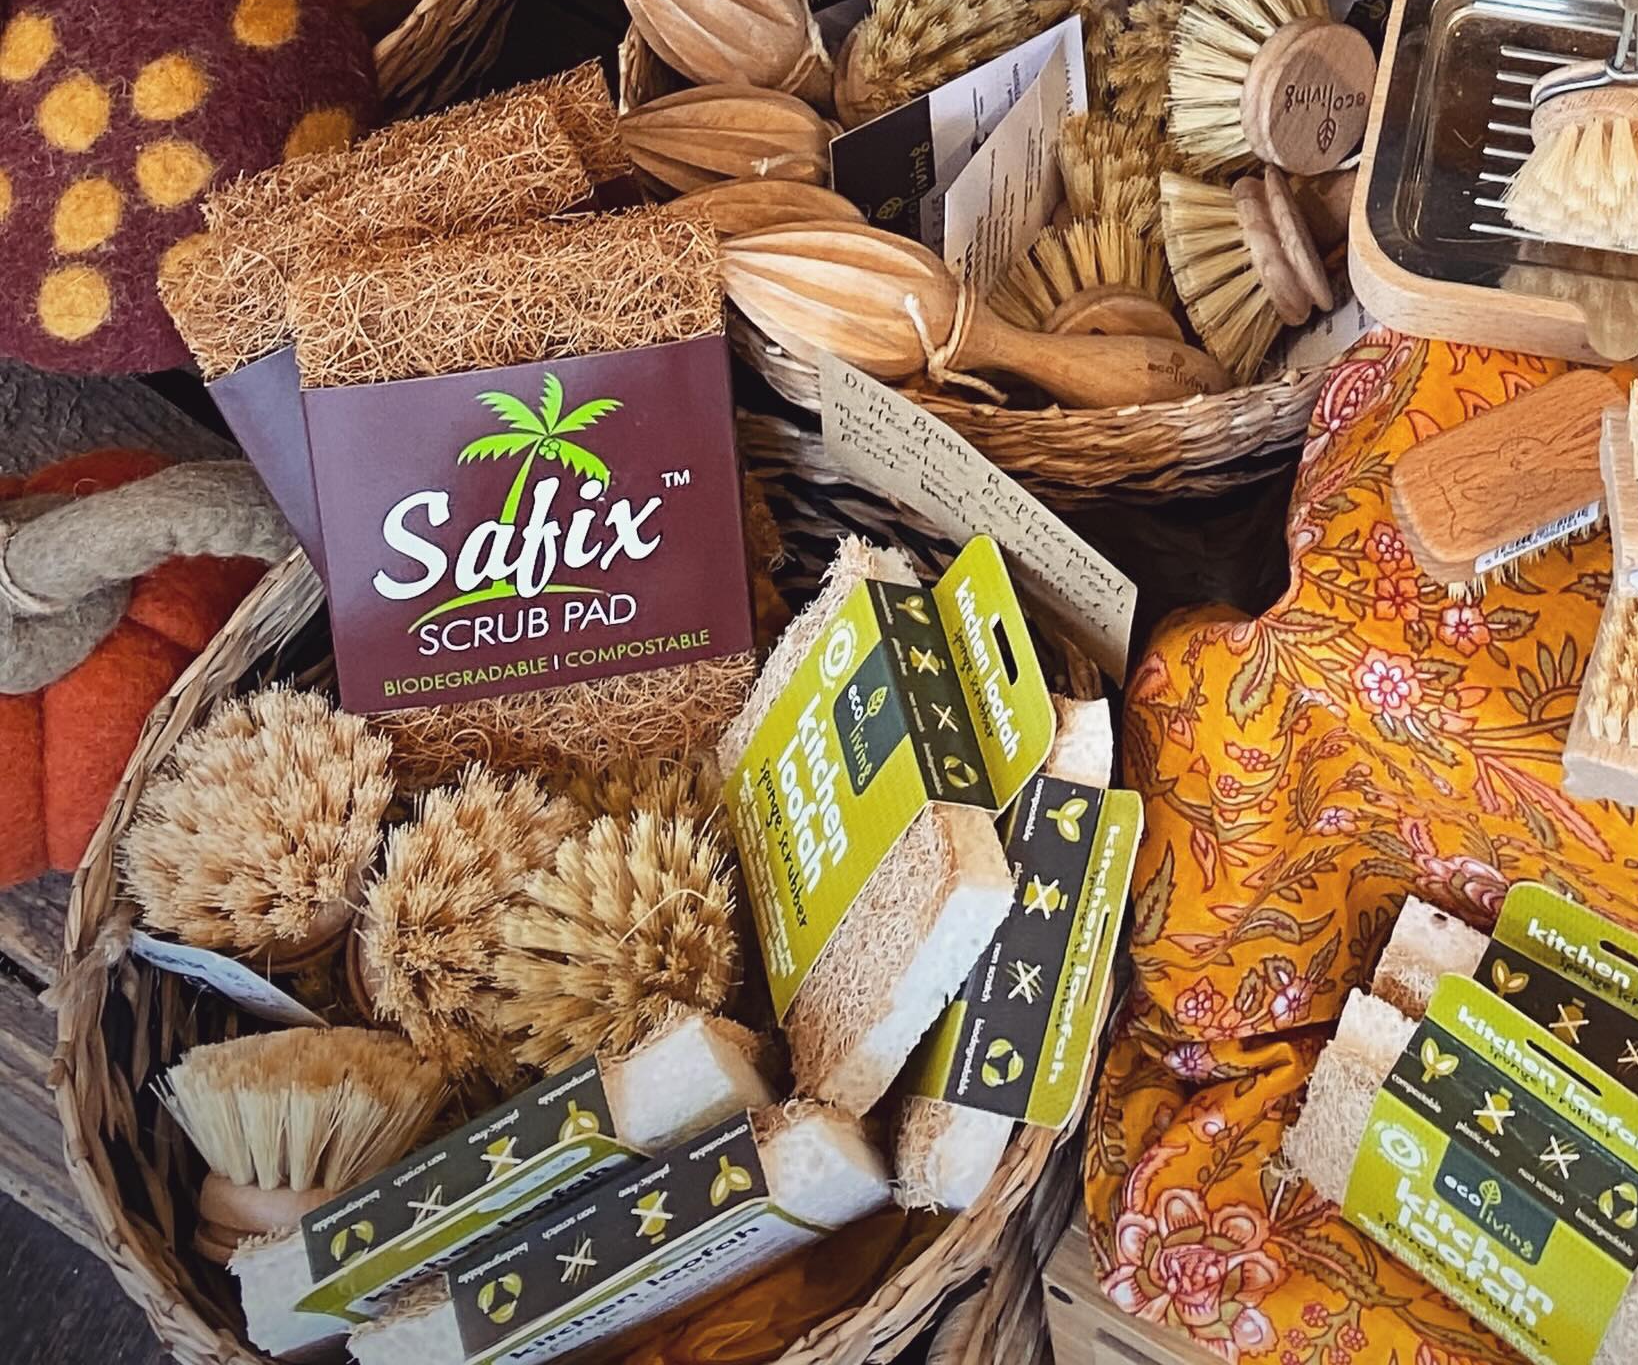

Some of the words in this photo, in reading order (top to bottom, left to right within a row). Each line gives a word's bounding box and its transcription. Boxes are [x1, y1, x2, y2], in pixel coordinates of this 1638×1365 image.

[371, 474, 663, 601] Safix
[383, 656, 550, 698] BIODEGRADABLE
[563, 628, 712, 670] COMPOSTABLE
[417, 608, 550, 658] SCRUB
[562, 592, 638, 634] PAD
[954, 576, 992, 683] kitchen
[983, 679, 1022, 763] loofah
[776, 733, 827, 896] loofah
[796, 692, 849, 867] kitchen
[1022, 778, 1045, 843] compostable
[1527, 918, 1632, 989] kitchen
[956, 1018, 987, 1097] biodegradable
[1457, 1005, 1558, 1091] kitchen
[646, 1225, 760, 1287] loofah
[1394, 1175, 1555, 1317] kitchen
[1395, 1203, 1538, 1327] loofah
[509, 1291, 640, 1360] kitchen
